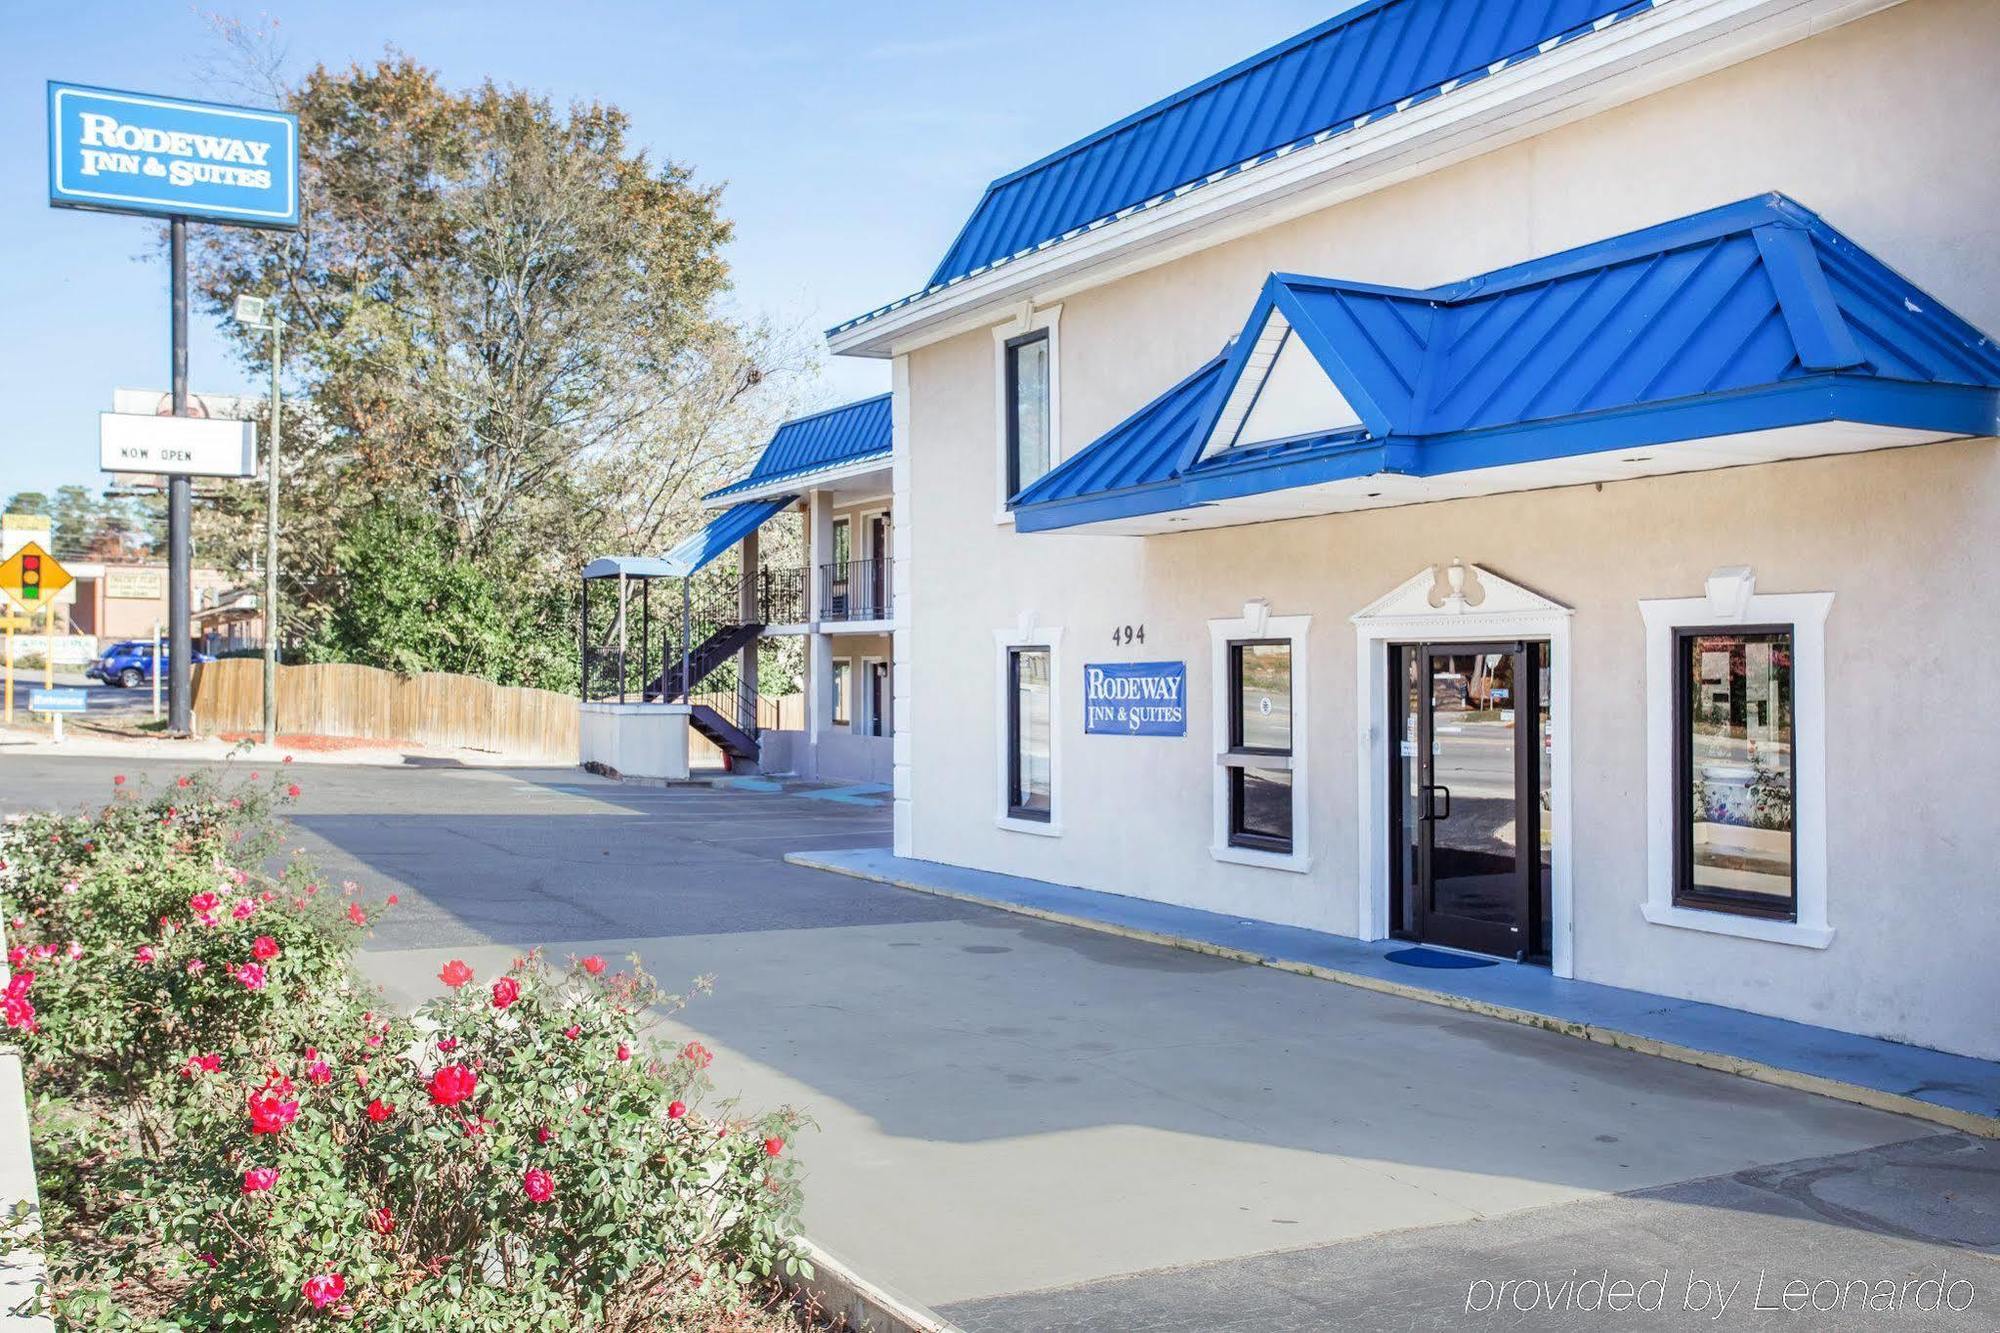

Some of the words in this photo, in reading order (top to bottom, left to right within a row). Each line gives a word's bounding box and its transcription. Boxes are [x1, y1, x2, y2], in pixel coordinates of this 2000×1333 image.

[79, 112, 271, 165] RODEWAY
[80, 150, 141, 176] INN
[143, 157, 167, 177] &
[169, 160, 271, 189] SUITES
[121, 447, 149, 459] NOW
[161, 449, 192, 461] OPEN
[1112, 624, 1144, 646] 494
[1088, 669, 1181, 699] RODEWAY
[1088, 706, 1114, 728] INN
[1117, 706, 1127, 720] &
[1129, 706, 1182, 729] SUITES
